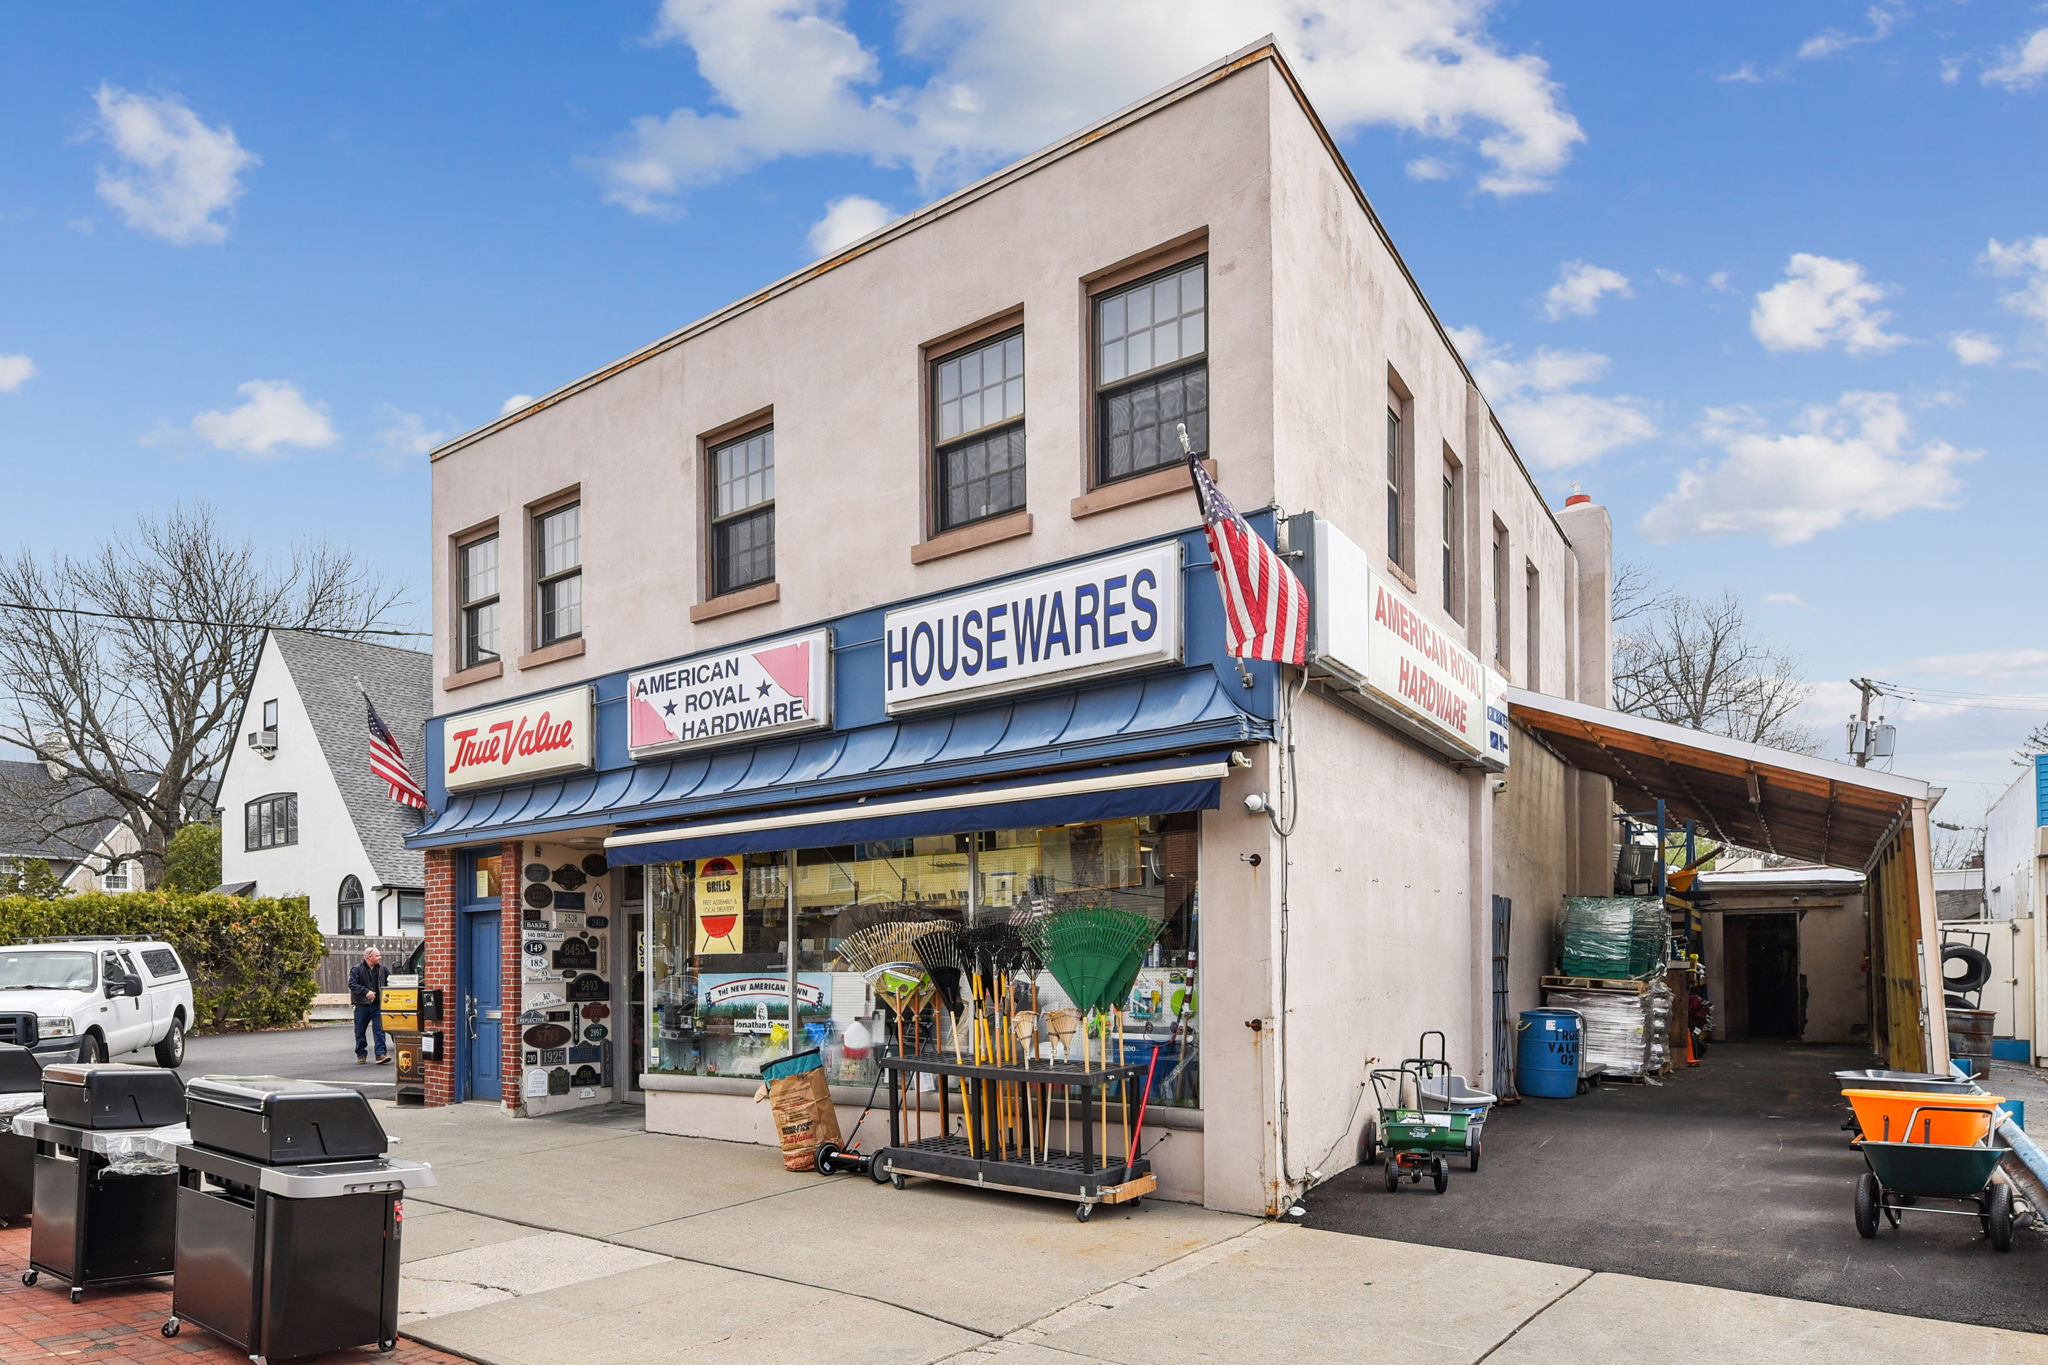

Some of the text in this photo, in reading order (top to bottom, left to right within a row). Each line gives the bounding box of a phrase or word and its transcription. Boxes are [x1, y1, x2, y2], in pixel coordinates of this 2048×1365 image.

[887, 568, 1157, 691] HOUSEWARES
[1374, 585, 1482, 699] AMERICAN ROYAL
[635, 657, 740, 697] AMERICAN
[684, 683, 750, 714] ROYAL
[1398, 655, 1468, 734] HARDWARE
[681, 698, 804, 741] HARDWARE
[448, 711, 573, 774] True Value
[706, 880, 731, 893] GRILLS
[593, 892, 603, 903] 49
[530, 944, 543, 952] 149
[565, 944, 585, 956] 8453
[530, 959, 543, 967] 185
[718, 988, 729, 996] THE
[731, 984, 747, 993] NEW
[749, 983, 785, 991] AMERICAN
[735, 1021, 766, 1029] Jonathan
[1554, 1030, 1579, 1041] TRUE
[527, 1054, 536, 1063] 210
[543, 1050, 564, 1063] 1925
